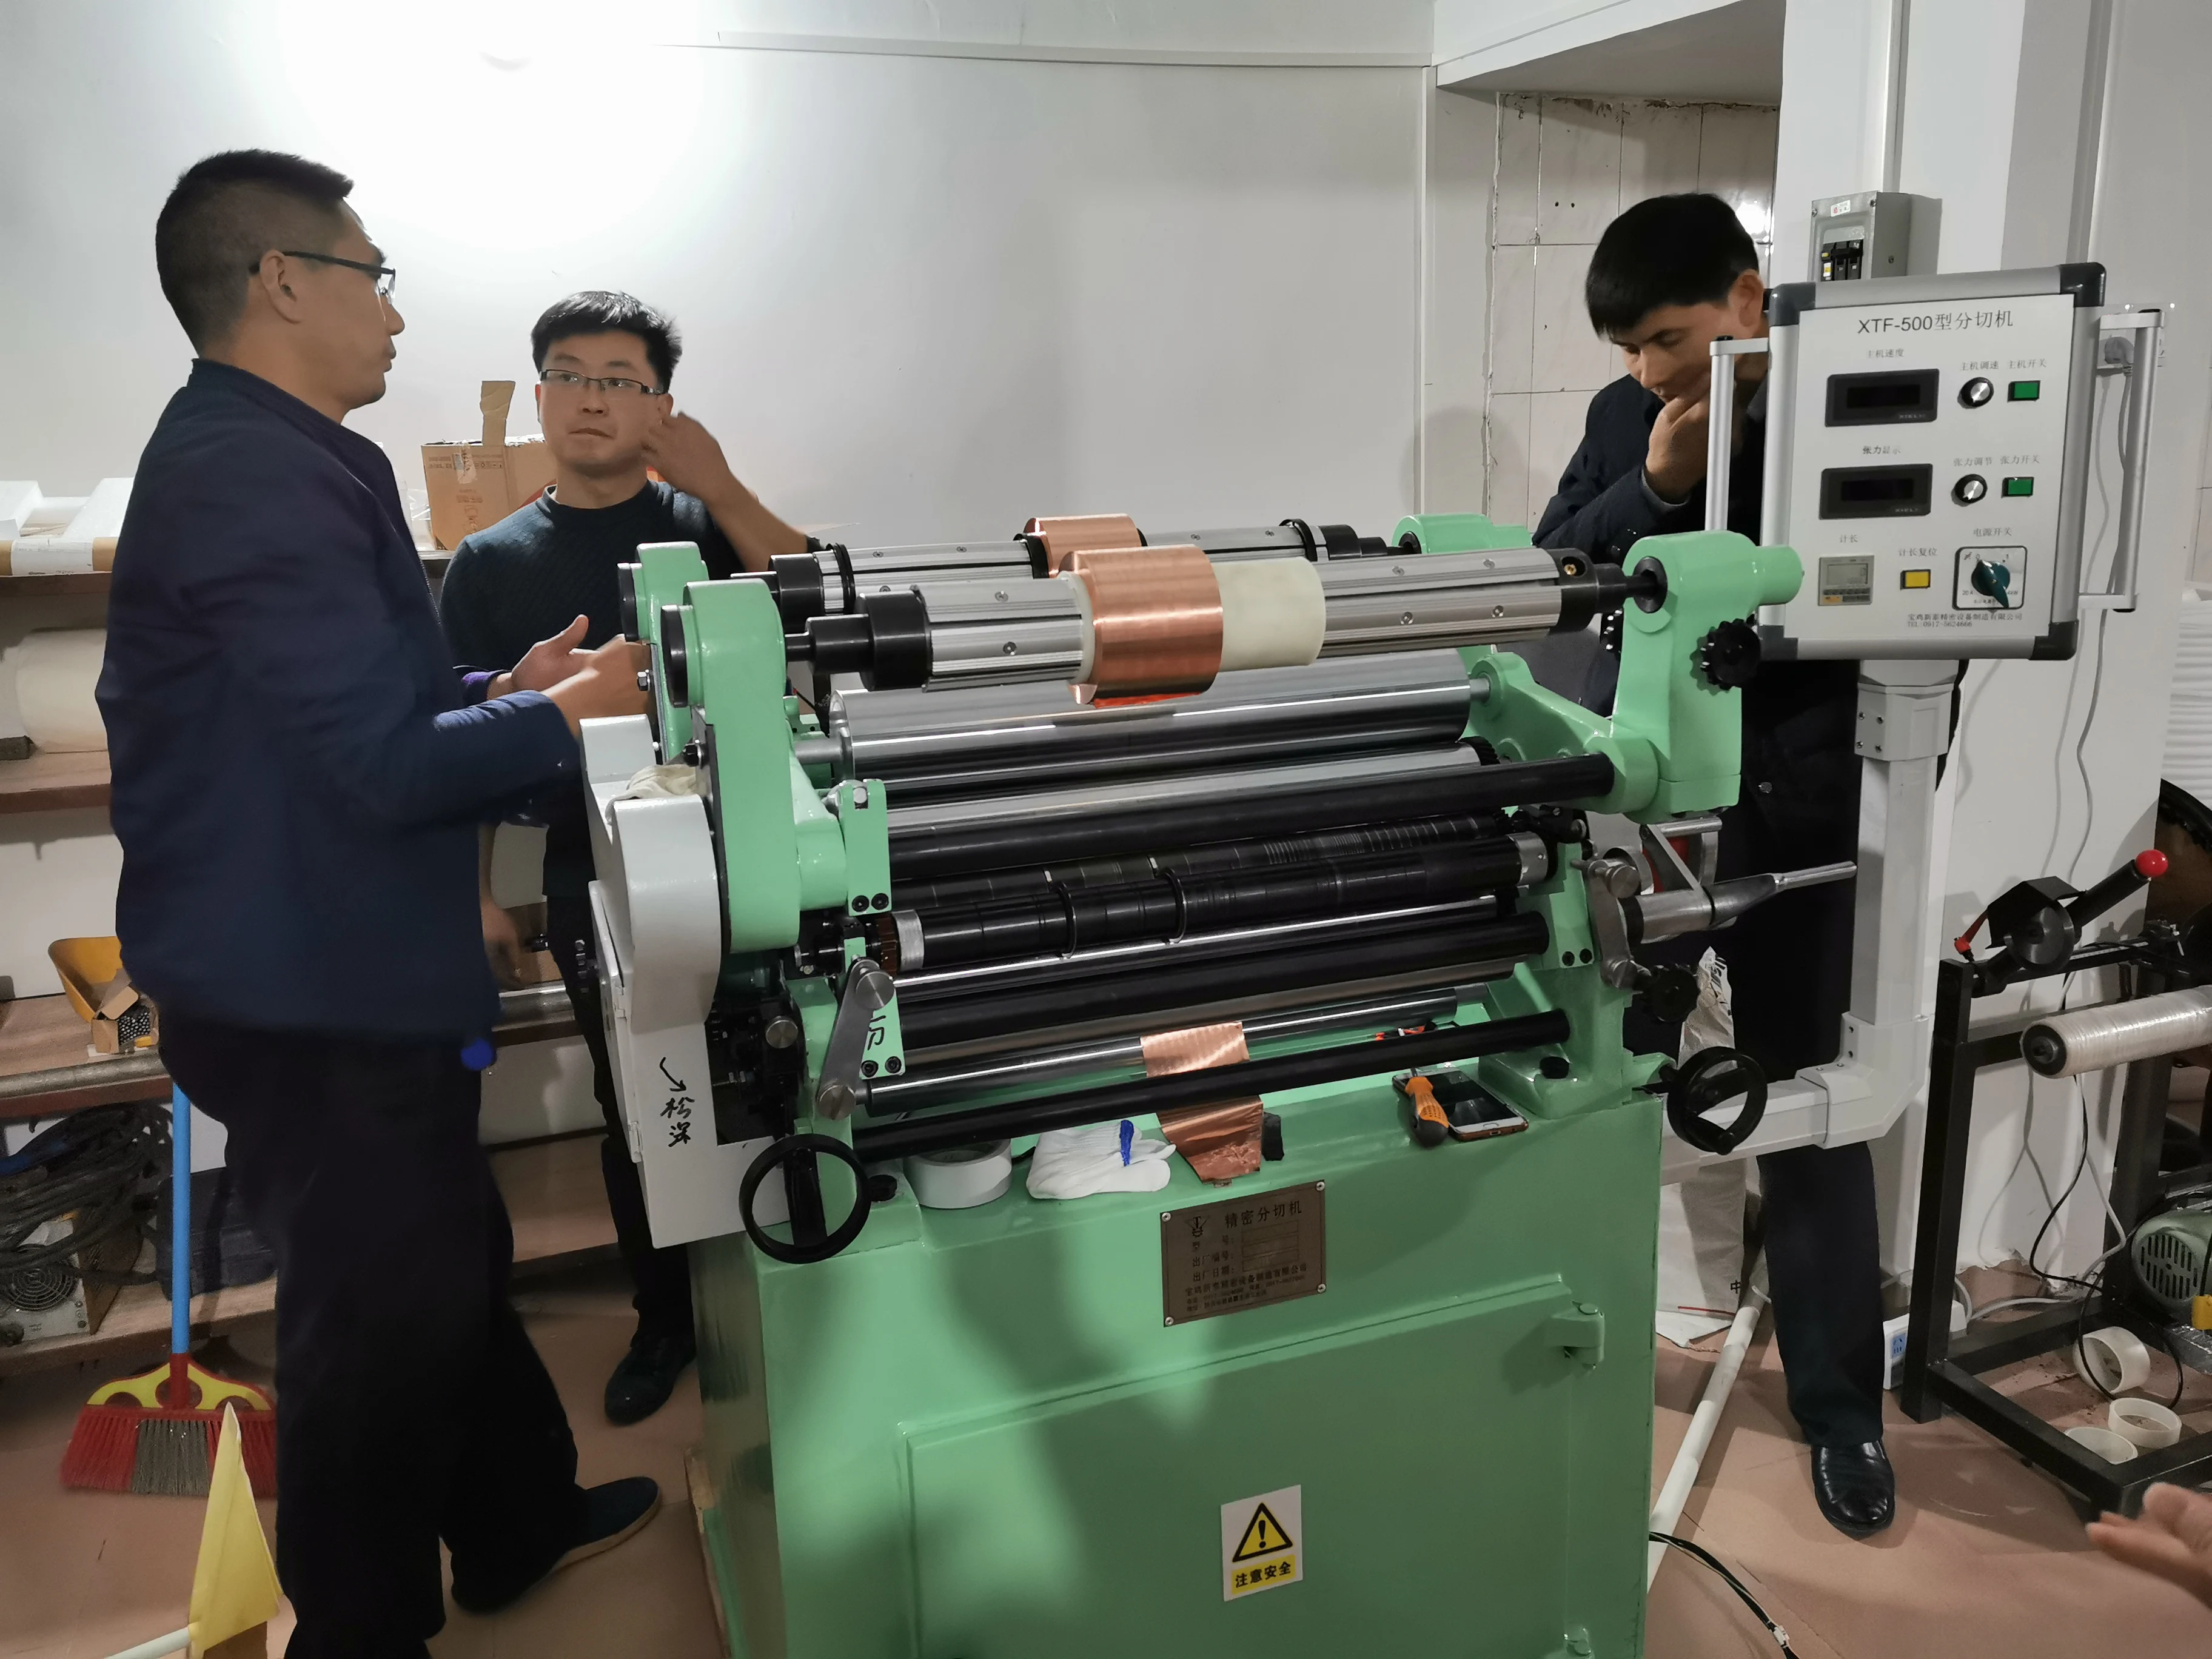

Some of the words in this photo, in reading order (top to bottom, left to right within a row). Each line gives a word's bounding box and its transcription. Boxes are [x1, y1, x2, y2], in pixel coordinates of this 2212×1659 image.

[1858, 310, 2013, 333] XTF-500型分切机
[1960, 360, 1999, 371] 主机调速
[2008, 358, 2047, 369] 主机开关
[1973, 527, 2013, 537] 电源开关
[1224, 1201, 1302, 1228] 精密分切机
[1235, 1561, 1292, 1588] 注意安全
